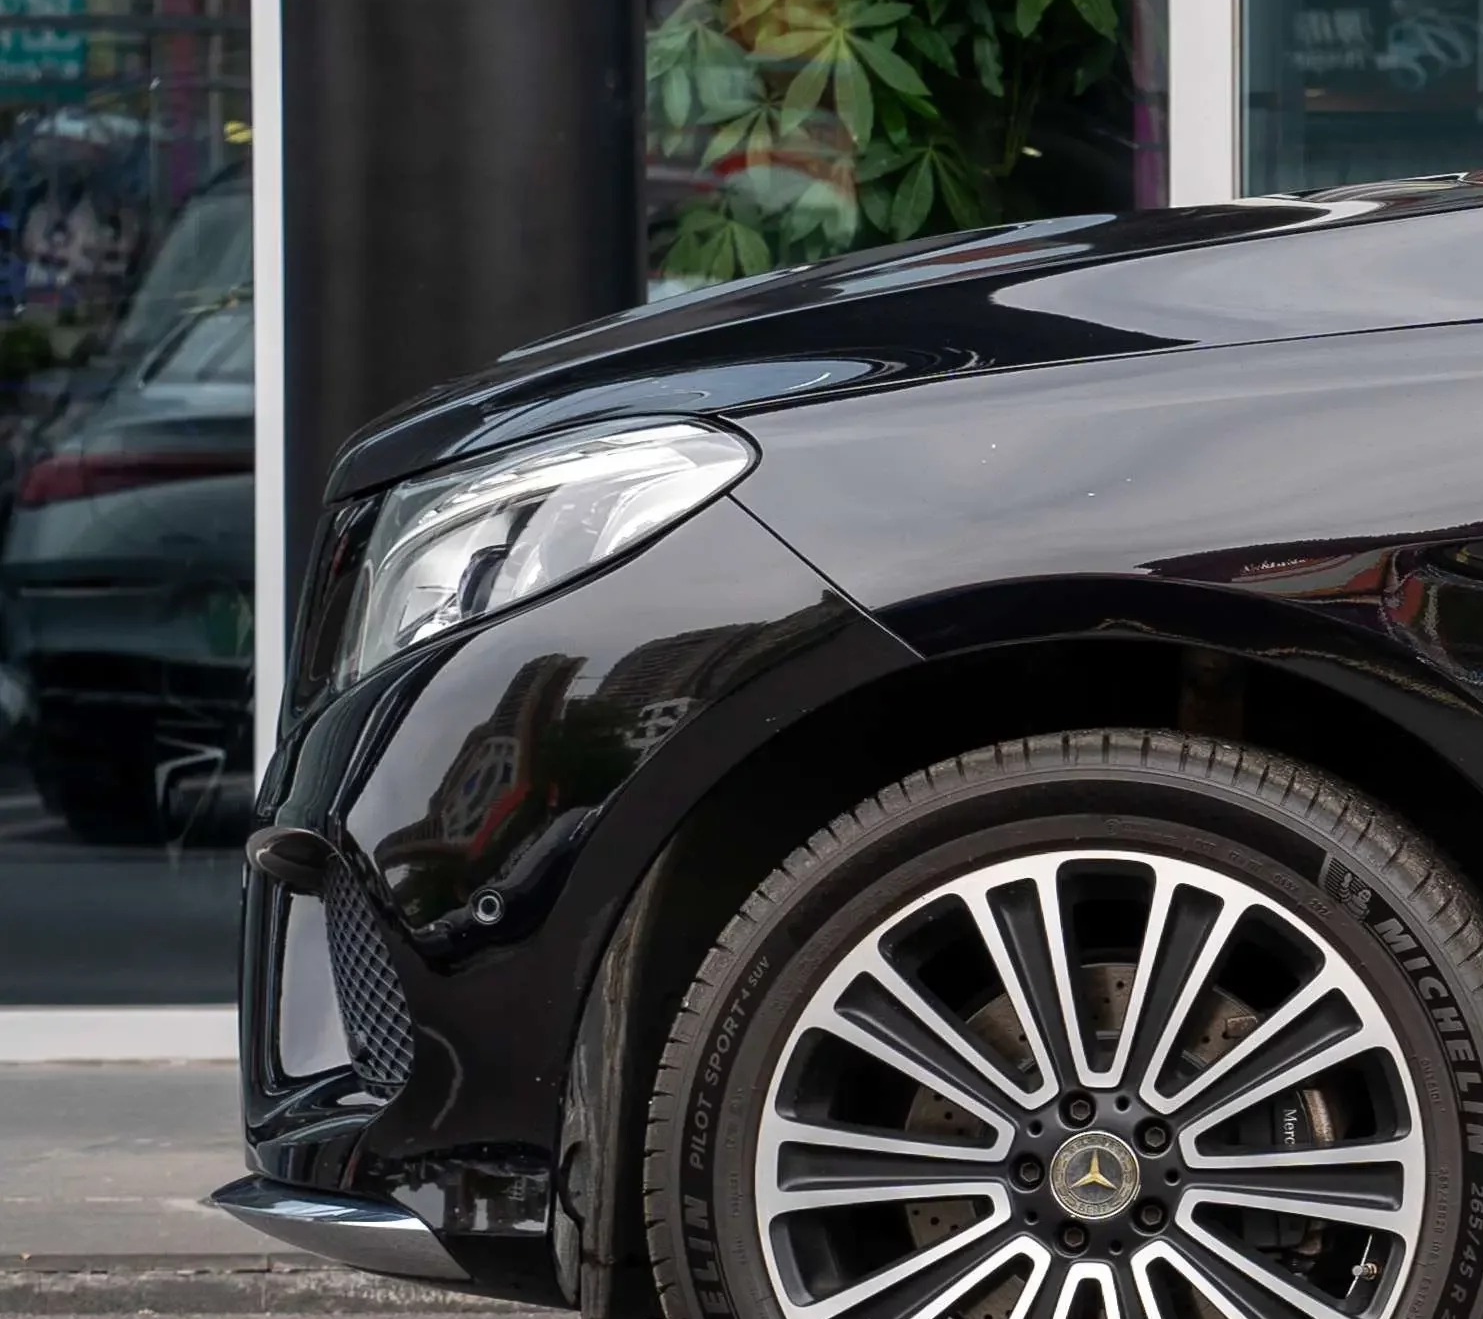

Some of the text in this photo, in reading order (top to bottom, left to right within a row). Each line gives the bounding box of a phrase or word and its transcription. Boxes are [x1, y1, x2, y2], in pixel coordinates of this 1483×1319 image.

[689, 1094, 715, 1171] PILOT
[705, 999, 748, 1086] SPORT
[748, 956, 771, 987] SUV
